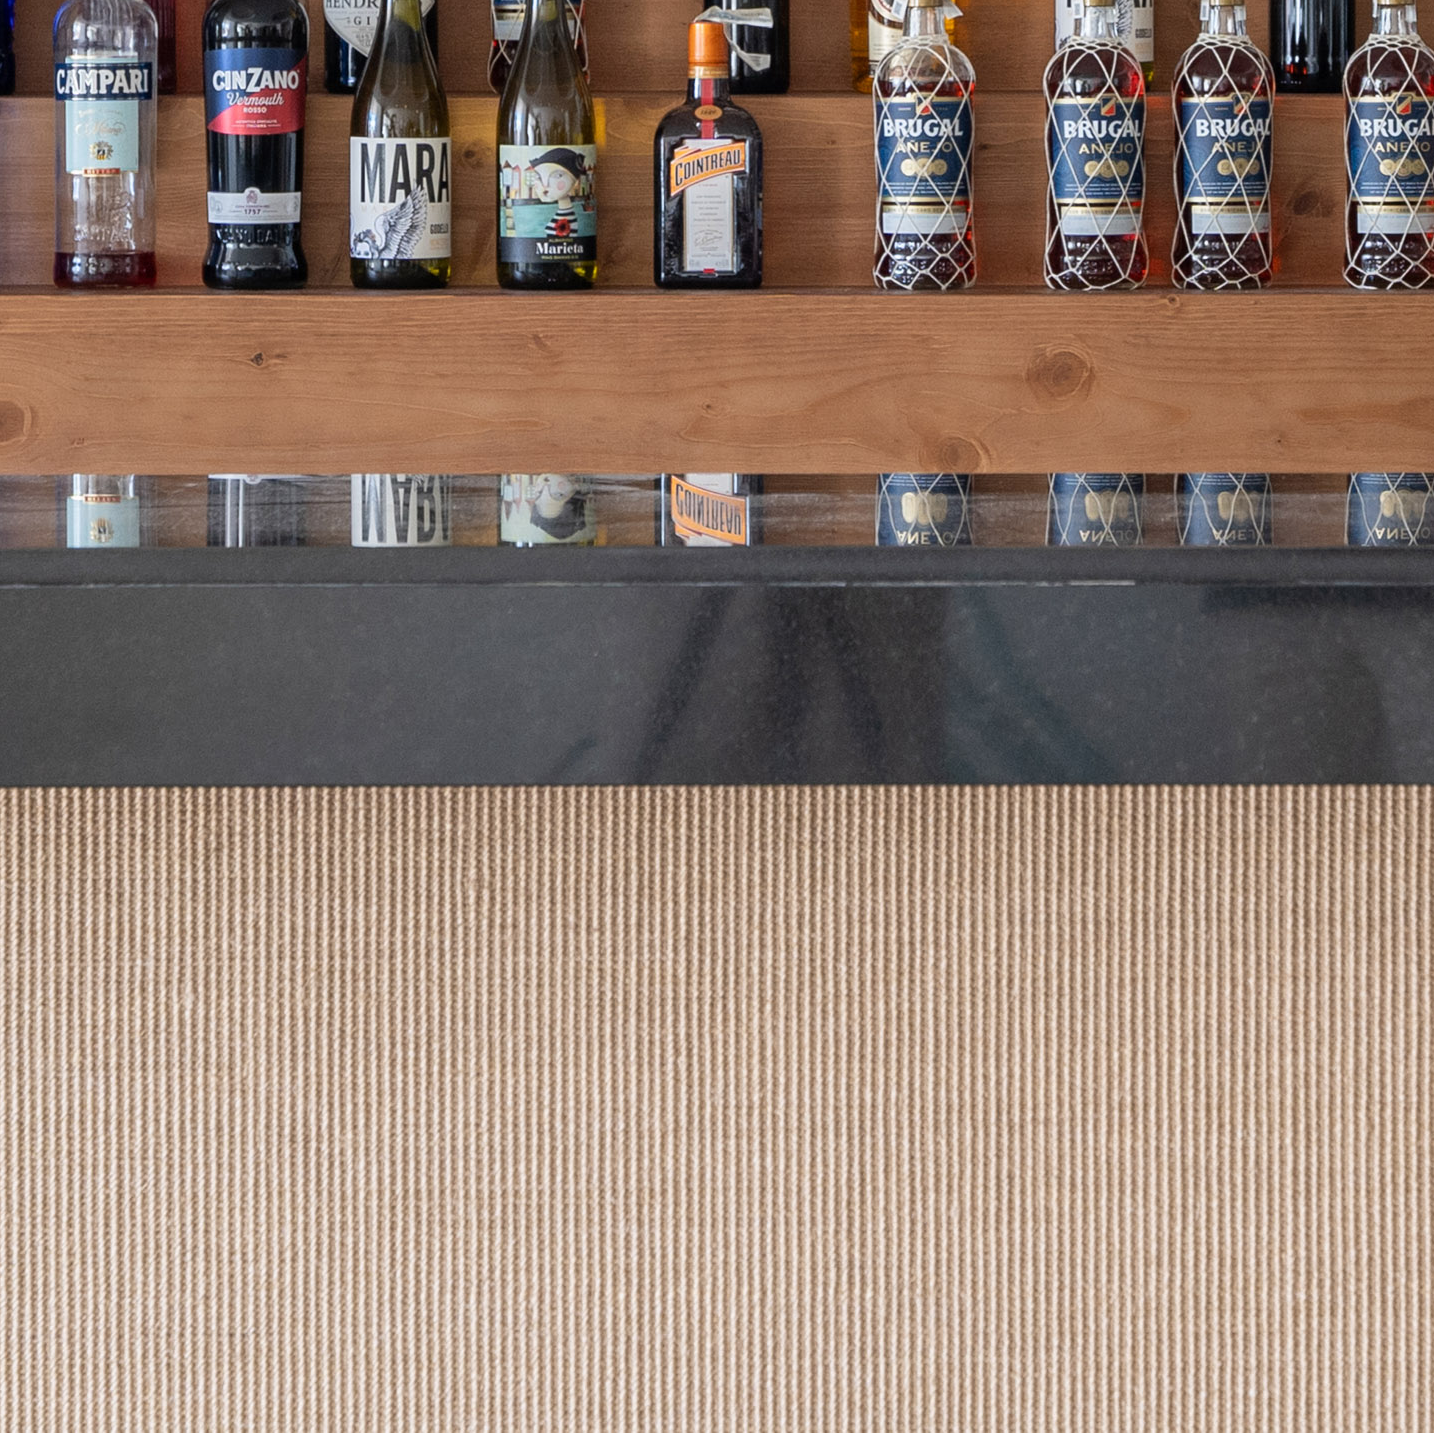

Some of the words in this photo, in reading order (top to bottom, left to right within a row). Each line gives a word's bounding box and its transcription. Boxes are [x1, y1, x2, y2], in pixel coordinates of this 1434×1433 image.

[353, 16, 378, 26] GI
[56, 68, 149, 95] CAMPARI
[212, 67, 299, 93] CINZANO
[226, 91, 284, 106] Vermouth
[883, 118, 963, 138] BRUGAL
[1063, 119, 1140, 139] BRUGAL
[1195, 118, 1270, 138] BRUGAL
[360, 142, 450, 203] MARA
[675, 149, 741, 187] COINTREAU
[535, 241, 584, 255] Marieta
